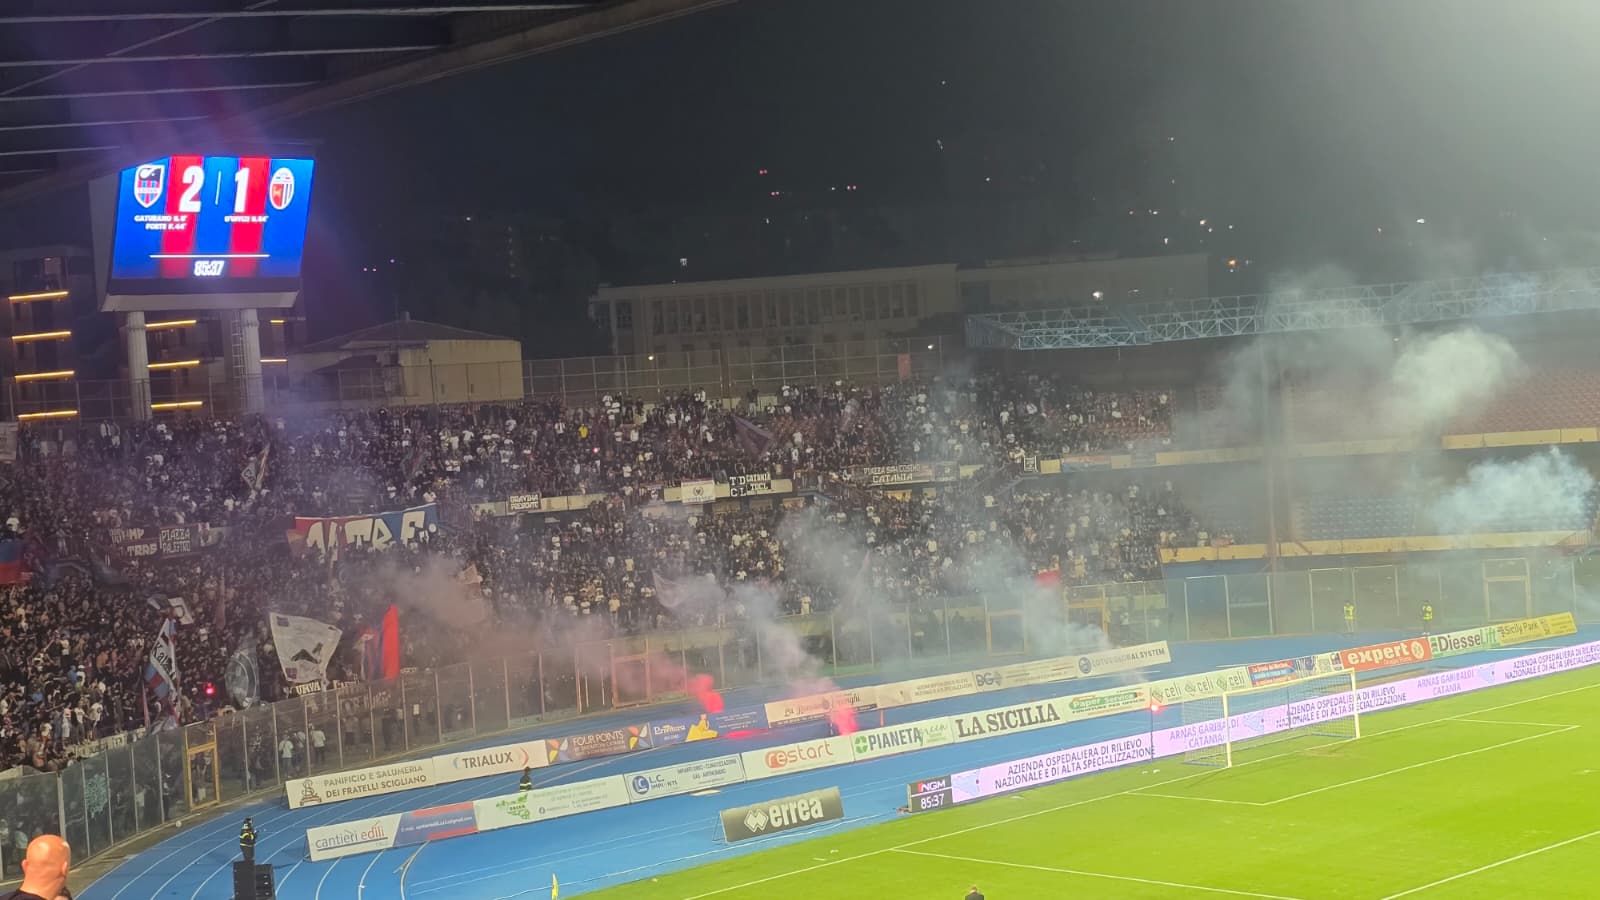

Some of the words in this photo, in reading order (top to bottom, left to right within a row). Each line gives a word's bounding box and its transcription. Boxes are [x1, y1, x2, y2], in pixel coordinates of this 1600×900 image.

[179, 165, 205, 212] 2
[234, 167, 250, 213] 1
[194, 260, 224, 276] 85:37
[872, 473, 912, 483] CATANIA
[161, 528, 190, 541] PIAZZA
[1140, 647, 1166, 658] SYSTEM
[1347, 643, 1409, 664] expert
[1197, 676, 1213, 692] celi
[1229, 671, 1245, 687] celi
[1417, 676, 1440, 689] ARNAS
[1440, 669, 1475, 686] GARIBALDI
[1165, 682, 1182, 698] celi
[1371, 686, 1396, 699] RILIEVO
[1433, 684, 1462, 697] CATANIA
[1330, 704, 1347, 717] ALTA
[956, 716, 985, 737] LA
[986, 703, 1060, 733] SICILIA
[573, 735, 596, 746] FOUR
[596, 730, 623, 742] POINTS
[868, 727, 921, 751] PIANETA
[1170, 727, 1197, 741] ARNAS
[1189, 734, 1224, 749] CATANIA
[462, 751, 513, 768] TRIALUX
[765, 740, 833, 769] restart
[1008, 759, 1043, 776] AZIENDA
[1046, 747, 1099, 767] OSPEDALIERA
[1101, 745, 1109, 754] DI
[1111, 738, 1142, 753] RILIEVO
[324, 774, 366, 787] PANIFICIO
[369, 772, 374, 780] E
[376, 765, 422, 779] SALUMERIA
[995, 770, 1043, 789] NAZIONALE
[1045, 768, 1049, 778] E
[1051, 766, 1059, 777] DI
[1061, 760, 1082, 774] ALTA
[1083, 747, 1156, 770] SPECIALIZZAZIONE
[326, 789, 340, 798] DEI
[342, 783, 378, 796] FRATELLI
[381, 774, 427, 789] SCIGLIANO
[648, 775, 665, 784] L.C.
[921, 779, 946, 793] NGM
[920, 793, 944, 809] 85:37
[769, 798, 824, 828] errea
[315, 831, 358, 849] cantieri
[361, 822, 385, 841] edili
